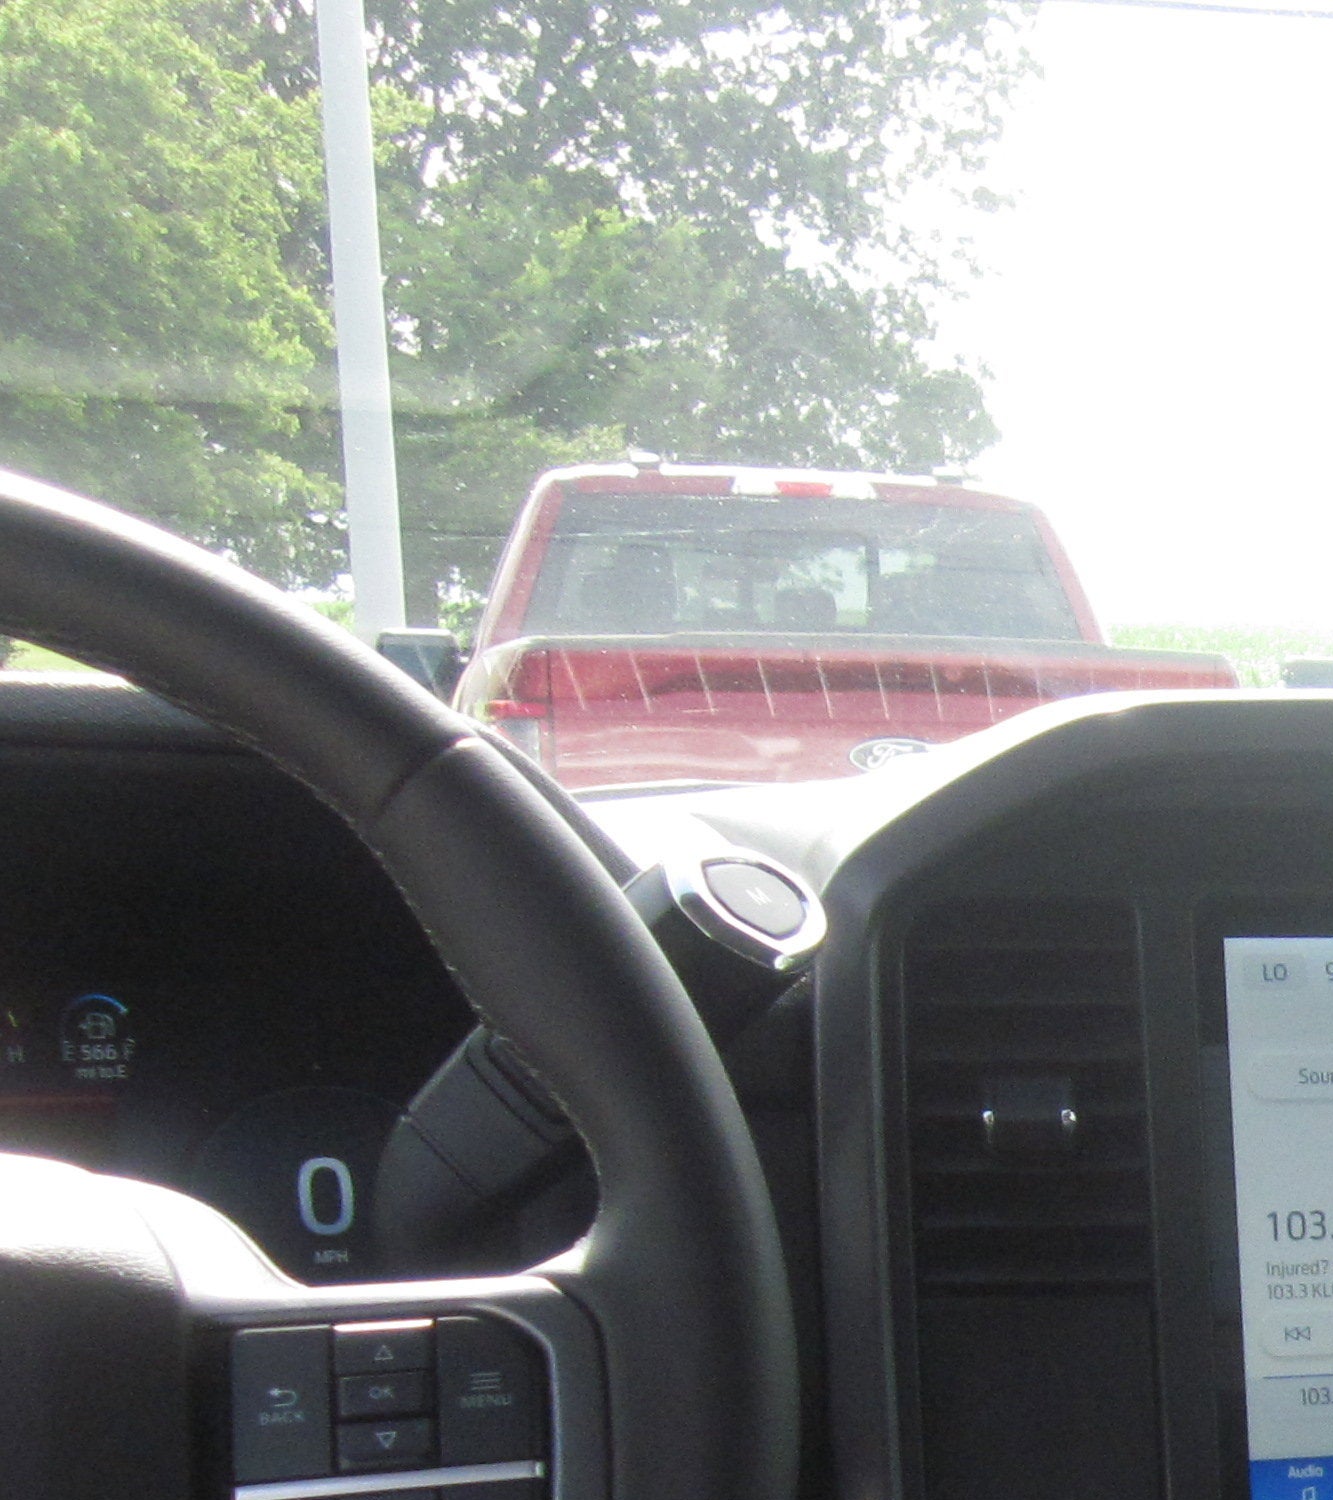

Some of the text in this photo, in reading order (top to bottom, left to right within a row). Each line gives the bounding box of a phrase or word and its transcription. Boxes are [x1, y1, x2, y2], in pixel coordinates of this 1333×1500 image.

[1262, 963, 1288, 982] LO
[298, 1157, 354, 1235] 0
[313, 1249, 349, 1264] MPH
[1266, 1258, 1330, 1277] Injured?
[1267, 1283, 1308, 1300] 103.3
[368, 1386, 395, 1399] OK
[1287, 1465, 1324, 1479] Audio
